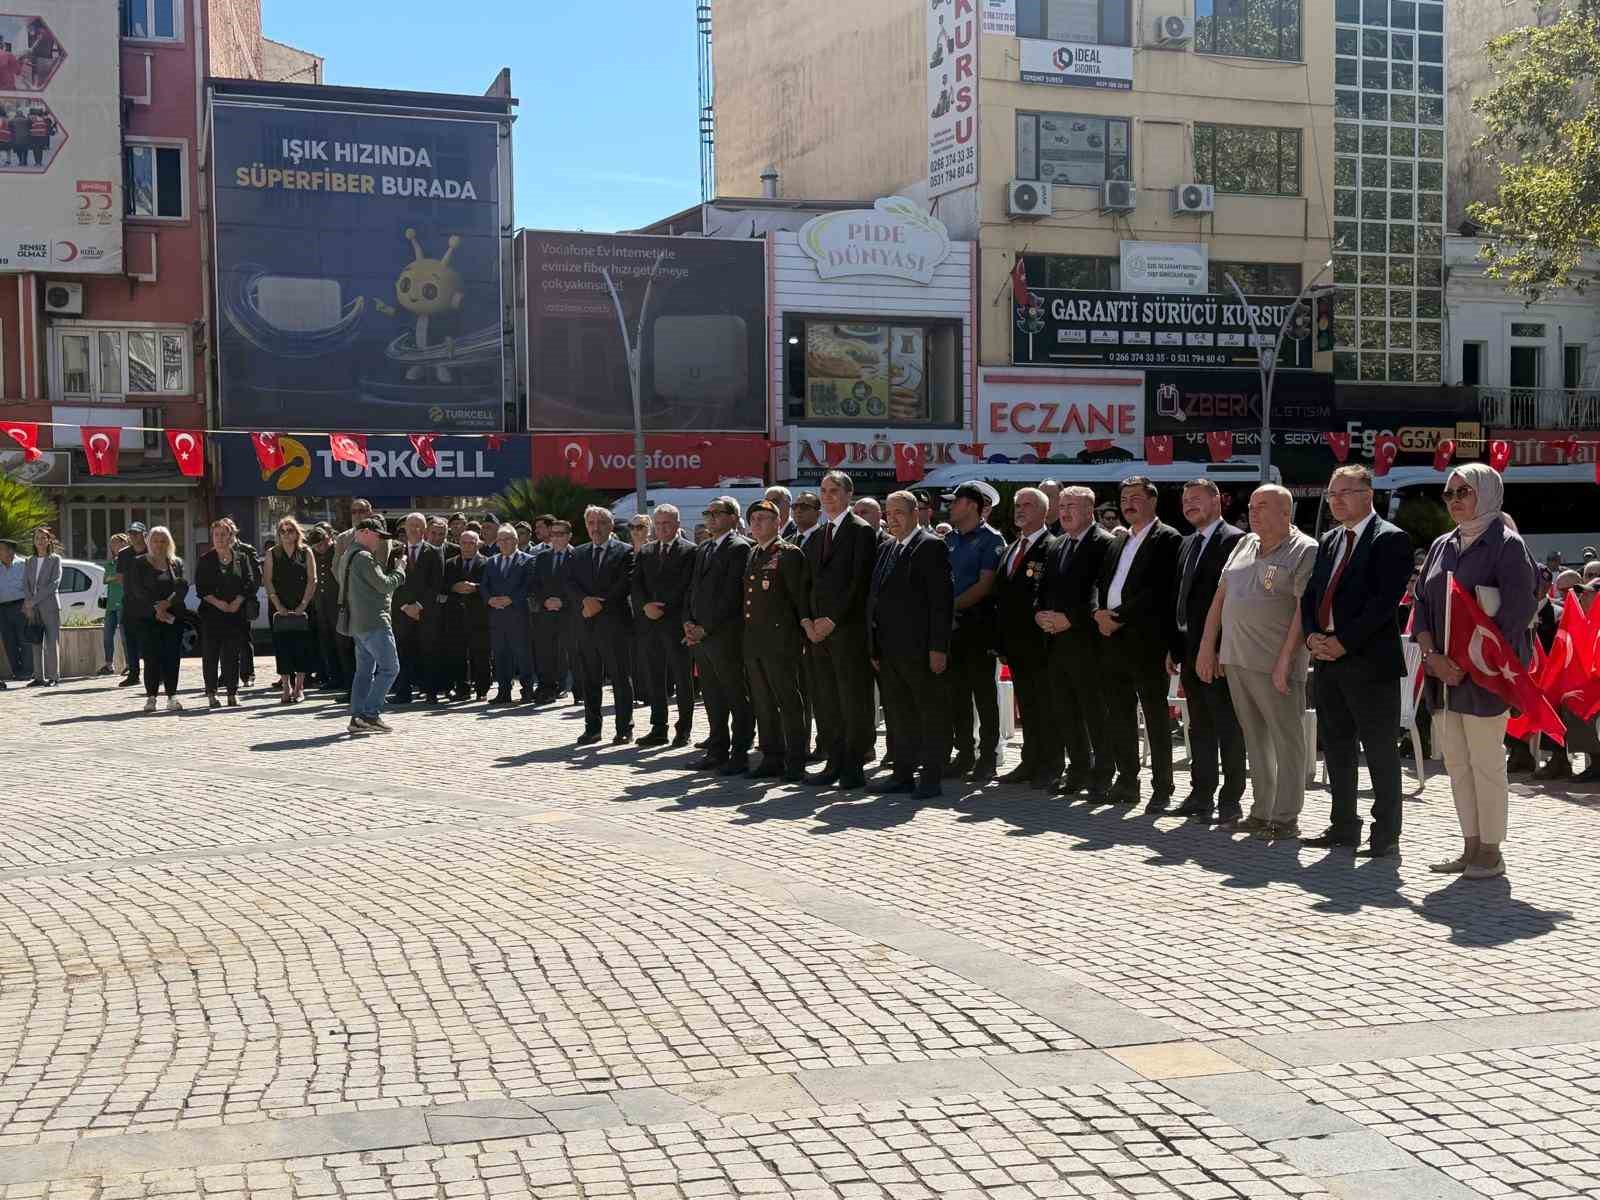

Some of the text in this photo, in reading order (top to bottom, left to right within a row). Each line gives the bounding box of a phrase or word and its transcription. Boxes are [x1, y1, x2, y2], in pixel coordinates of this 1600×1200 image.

[282, 138, 433, 168] IŞIK HIZINDA
[235, 162, 478, 200] SÜPERFİBER BURADA
[848, 219, 905, 244] PİDE
[829, 243, 927, 272] DÜNYASI
[1052, 296, 1138, 322] GARANTİ
[1142, 296, 1217, 326] SÜRÜCÜ
[990, 402, 1136, 434] ECZANE
